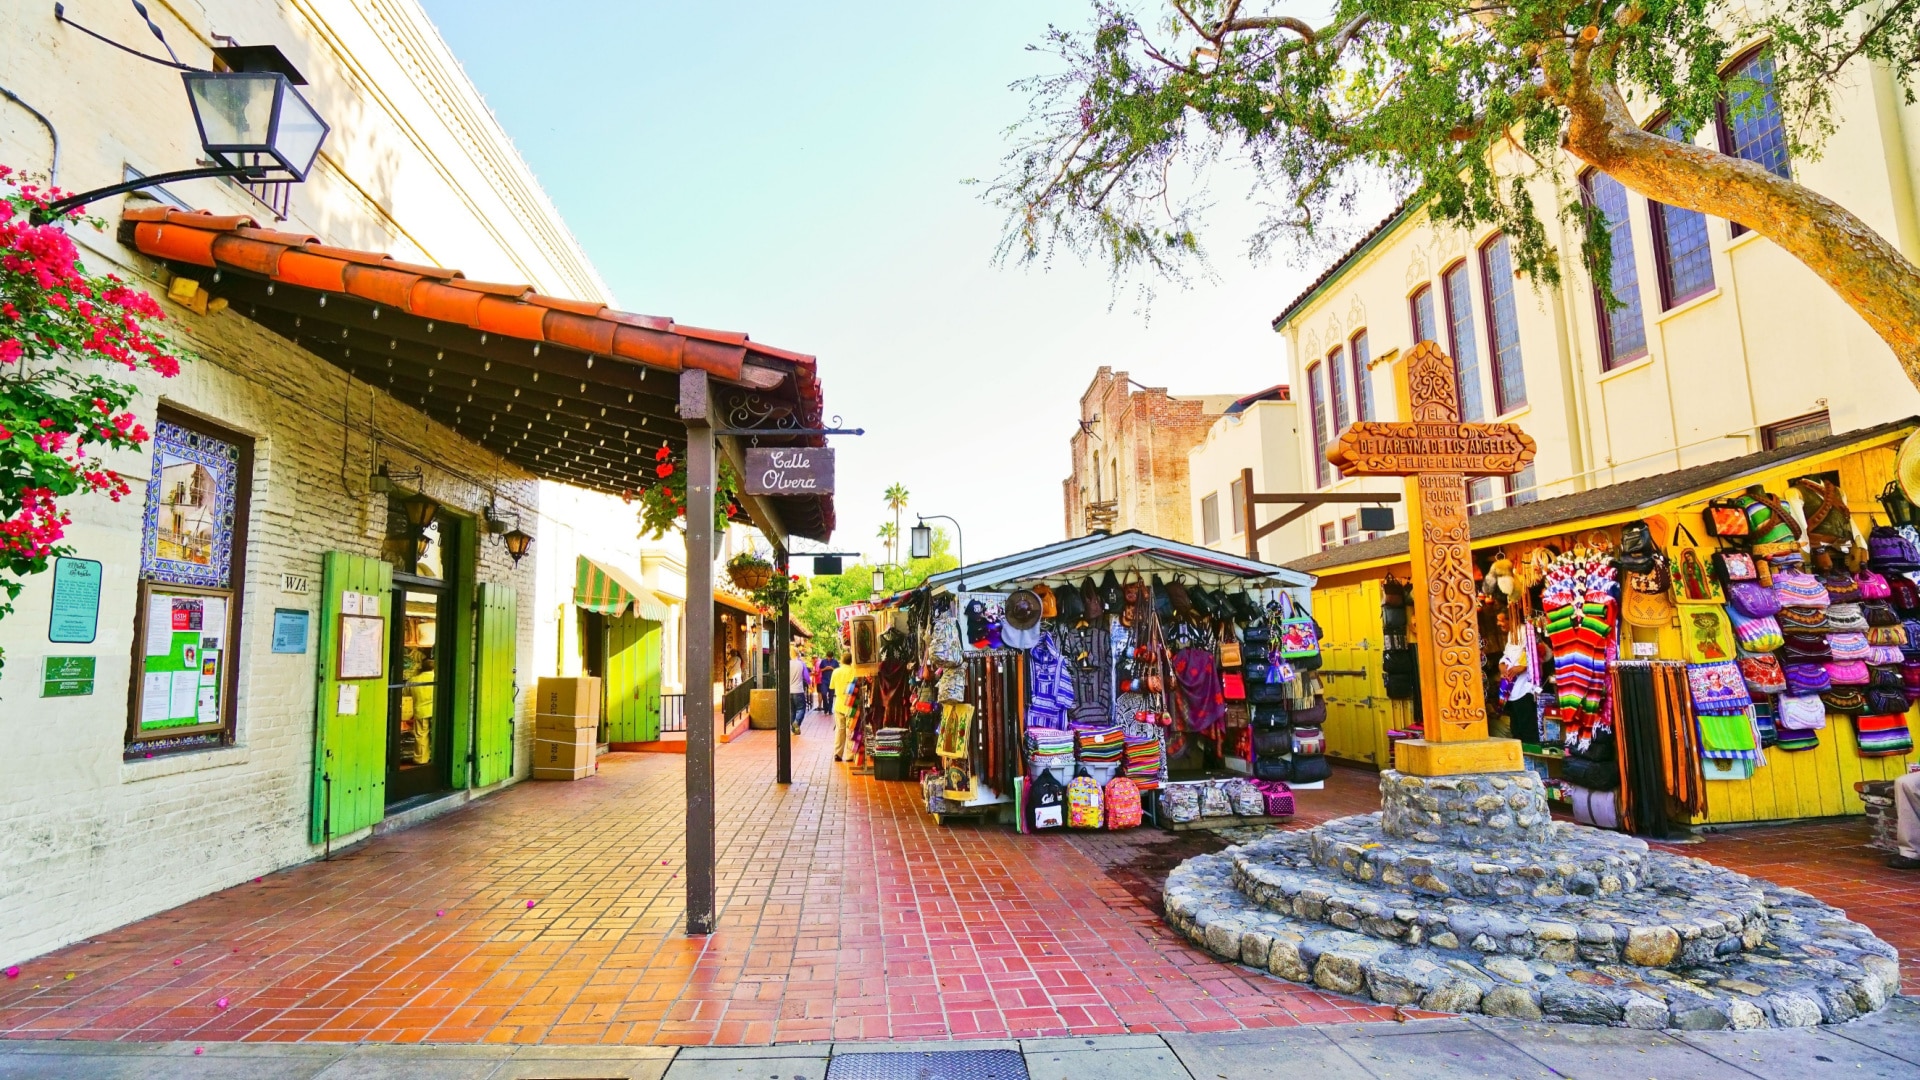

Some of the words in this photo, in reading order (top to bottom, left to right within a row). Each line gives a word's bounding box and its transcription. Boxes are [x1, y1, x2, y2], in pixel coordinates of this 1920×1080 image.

[1428, 408, 1443, 420] EL
[1419, 425, 1458, 437] PUEBLO
[1360, 440, 1374, 454] DE
[1378, 440, 1392, 454] LA
[1393, 440, 1428, 454] REYNA
[1430, 440, 1445, 454] DE
[1446, 440, 1467, 454] LOS
[1468, 440, 1518, 454] ANGELES
[770, 451, 811, 469] Calle
[1398, 457, 1435, 468] FELIPE
[1437, 457, 1449, 468] DE
[1452, 457, 1480, 468] NEVE
[762, 469, 817, 490] Olvera
[1420, 476, 1463, 488] SEPTEMBER
[1425, 490, 1460, 502] FOURTH
[1433, 504, 1455, 517] 1781
[838, 603, 868, 622] ATM
